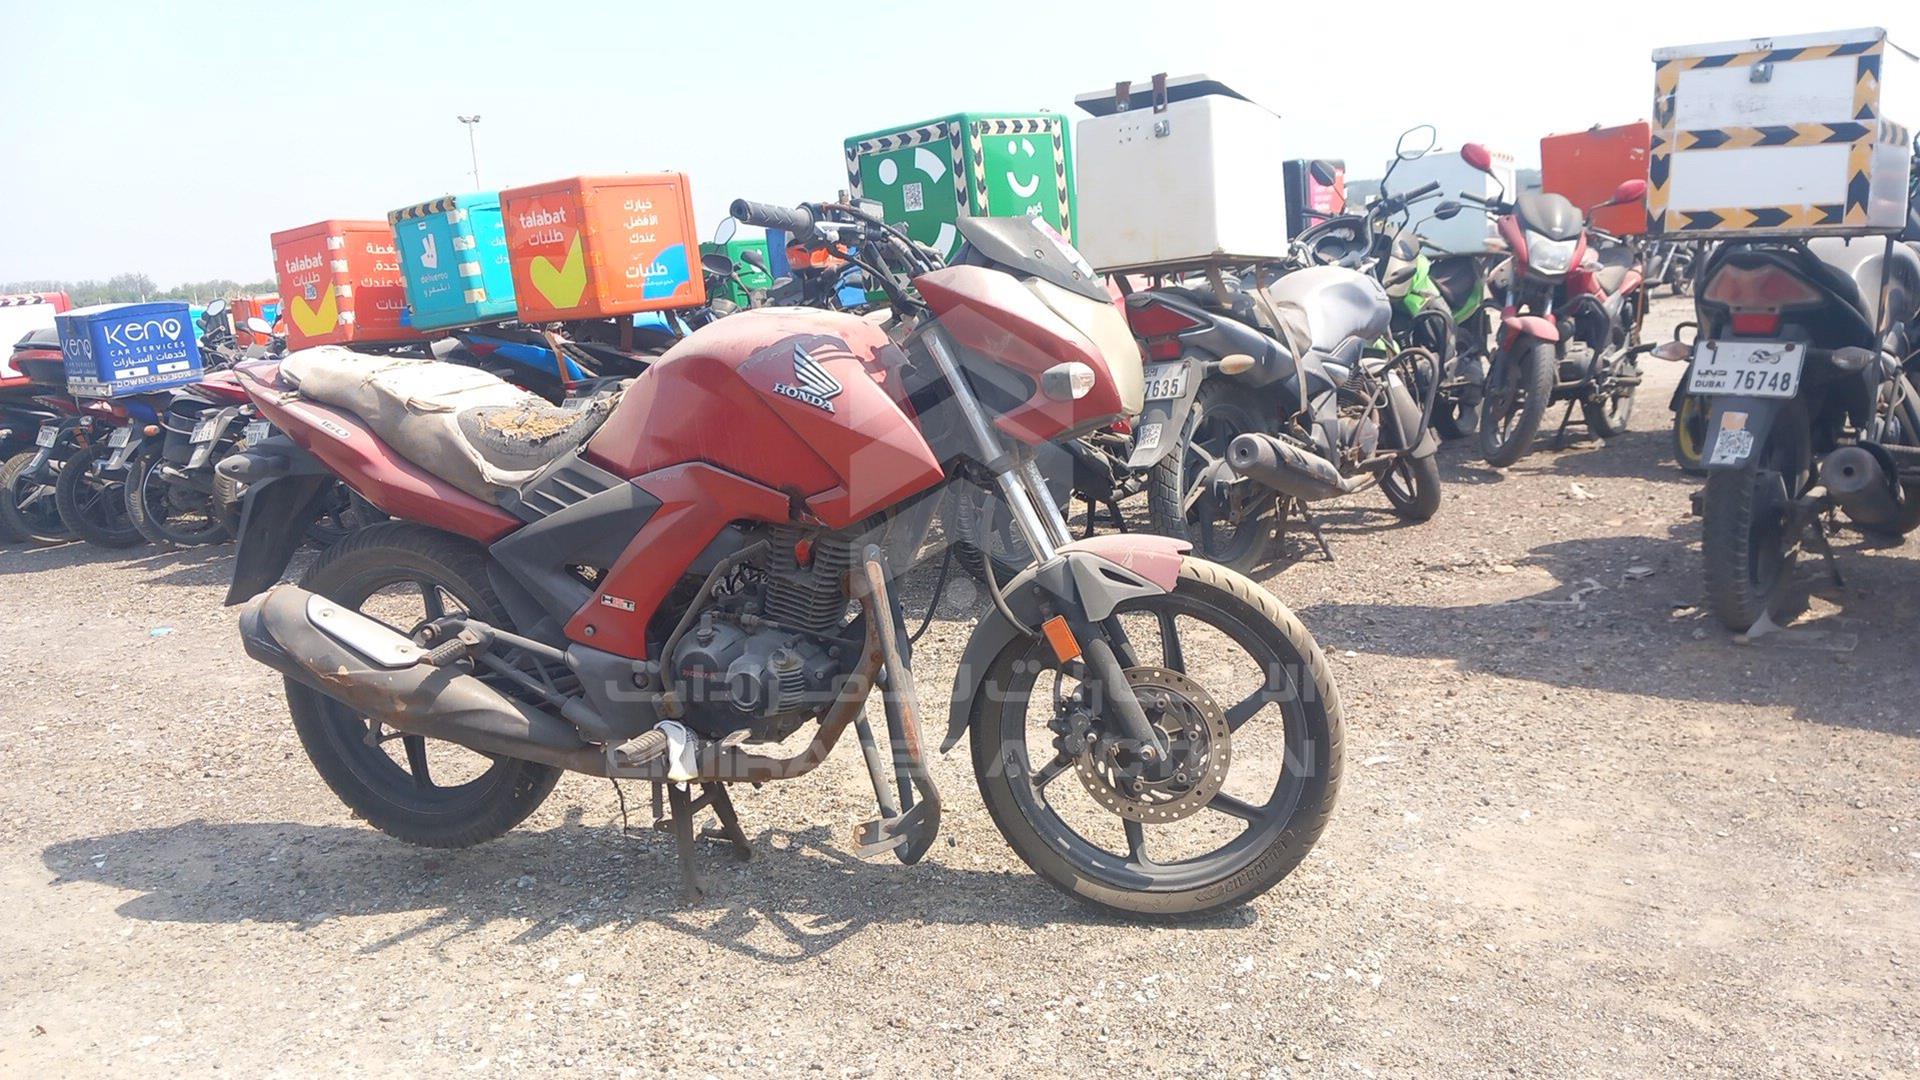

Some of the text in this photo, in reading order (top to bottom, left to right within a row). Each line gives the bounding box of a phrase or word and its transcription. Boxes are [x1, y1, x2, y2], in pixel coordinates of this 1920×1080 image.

[519, 206, 567, 229] talabat
[528, 229, 564, 249] طلبات
[285, 251, 324, 274] talabat
[625, 262, 669, 279] طلبات
[292, 271, 321, 287] طلبات
[110, 341, 186, 357] CAR SERVICES
[112, 349, 187, 368] لخدمات السيارات
[1695, 380, 1726, 388] DUBAI
[1733, 370, 1791, 392] 76748
[772, 382, 836, 414] HONDA
